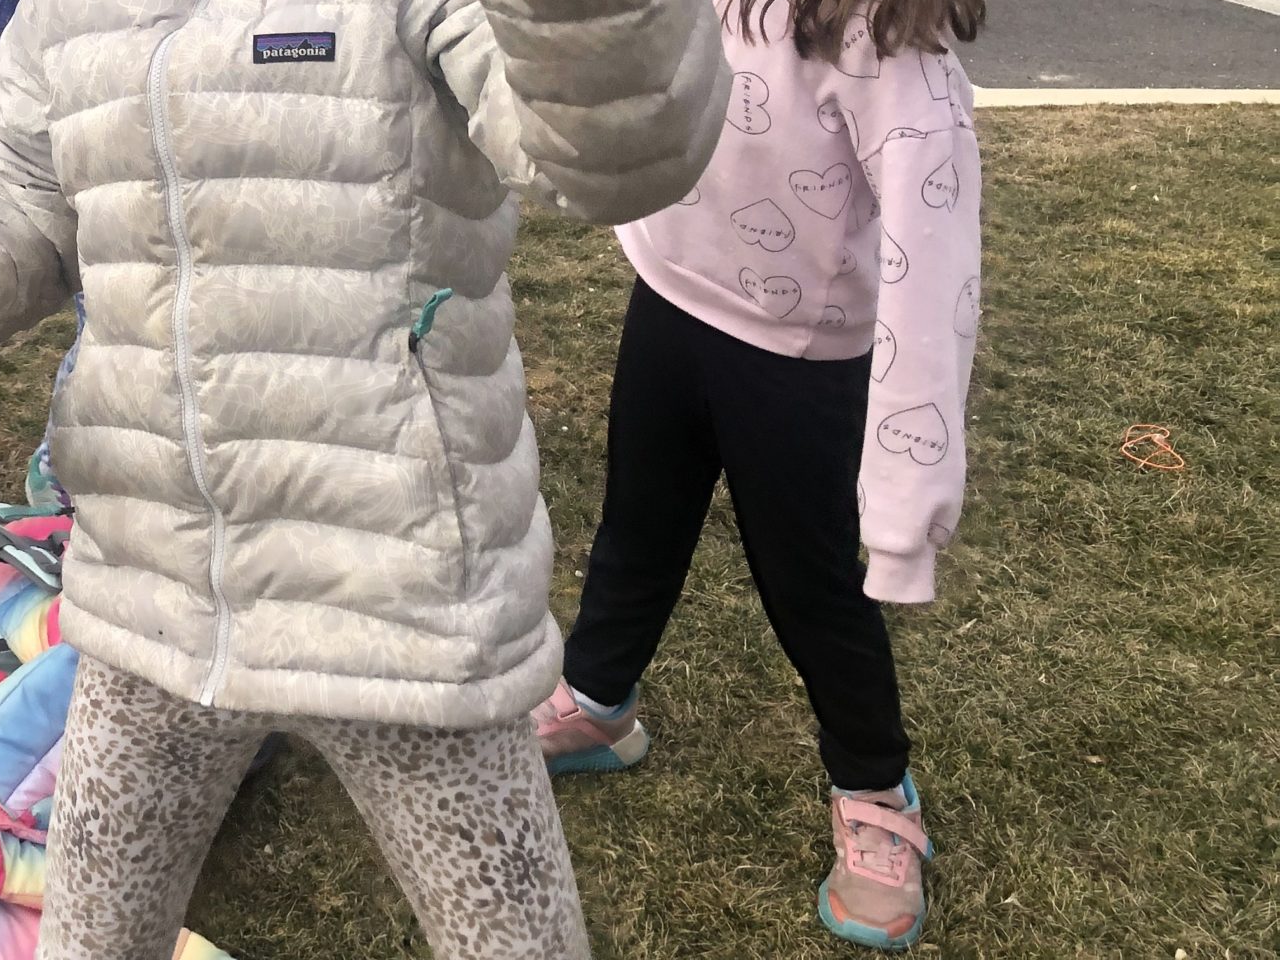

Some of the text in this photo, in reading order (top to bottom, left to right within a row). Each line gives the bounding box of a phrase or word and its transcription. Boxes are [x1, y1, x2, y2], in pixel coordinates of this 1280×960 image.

[262, 46, 327, 59] patagonia
[740, 75, 753, 131] FRIENDS
[883, 424, 946, 452] FRIENDS
